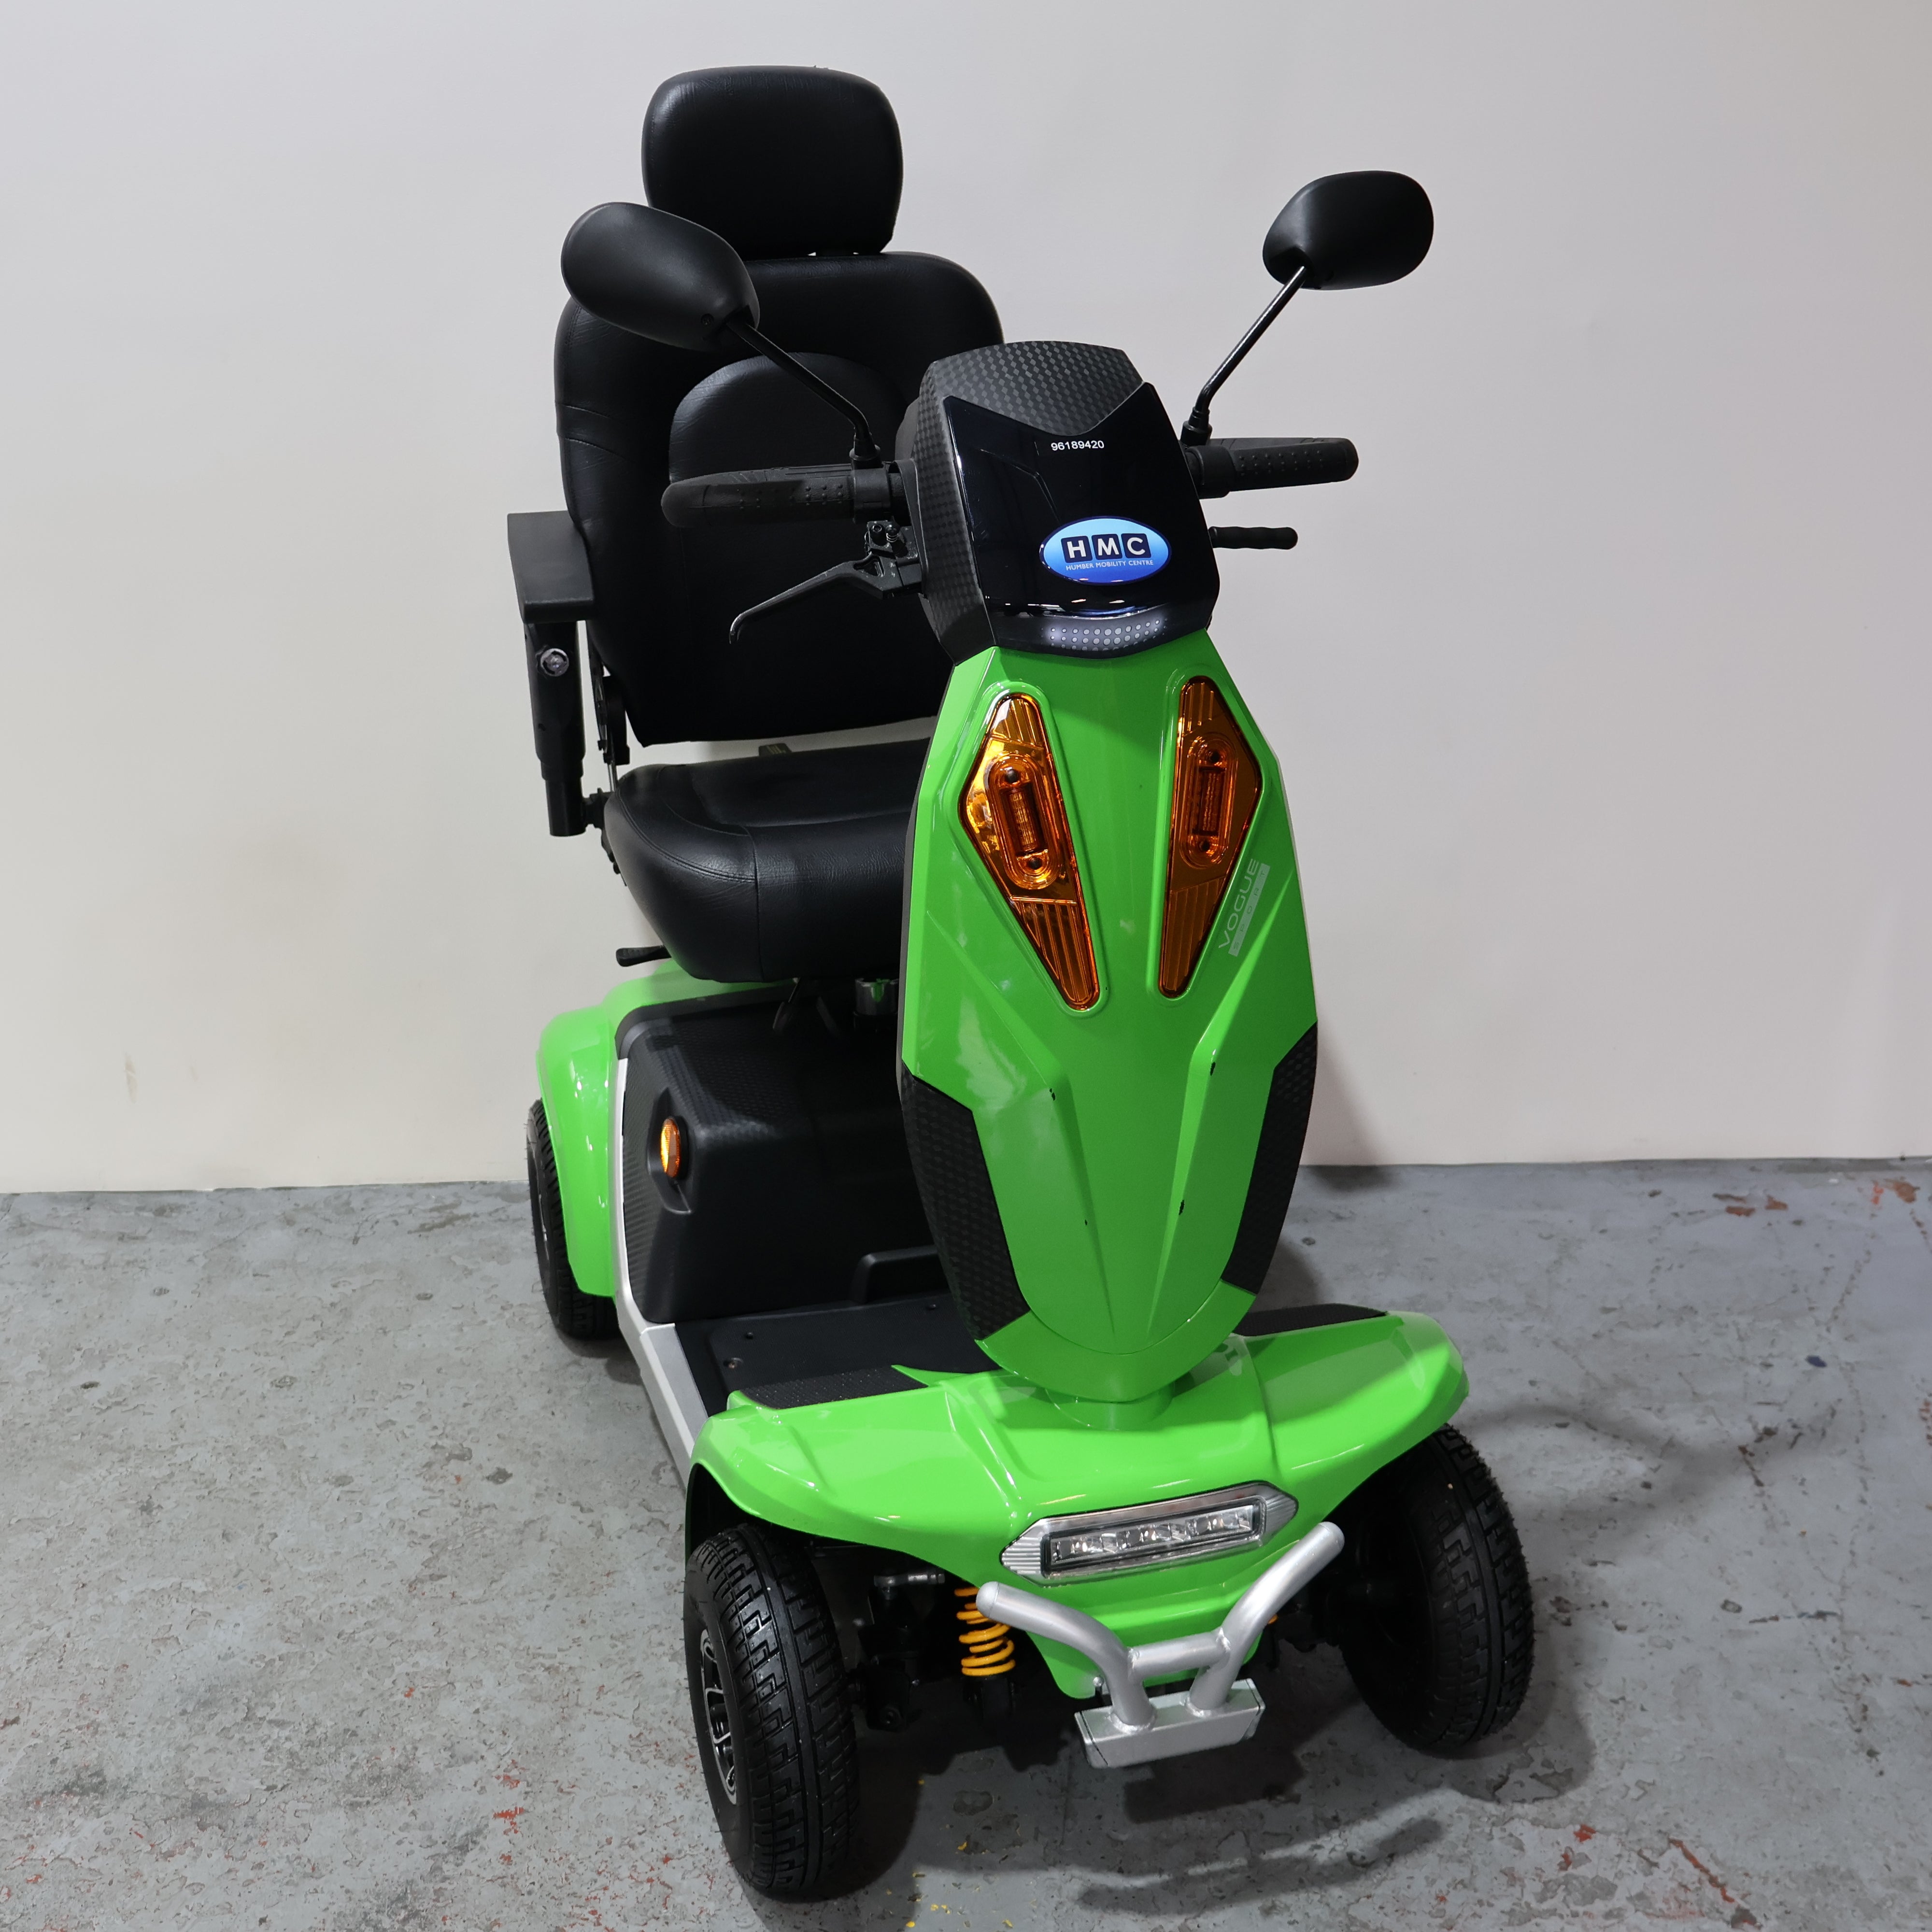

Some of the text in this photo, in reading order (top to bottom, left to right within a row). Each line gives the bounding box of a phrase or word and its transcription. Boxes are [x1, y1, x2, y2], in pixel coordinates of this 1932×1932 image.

[1051, 440, 1105, 451] 96189420
[1066, 537, 1145, 558] HMC
[1219, 858, 1259, 948] VOGUE
[1233, 870, 1265, 950] SPORT
